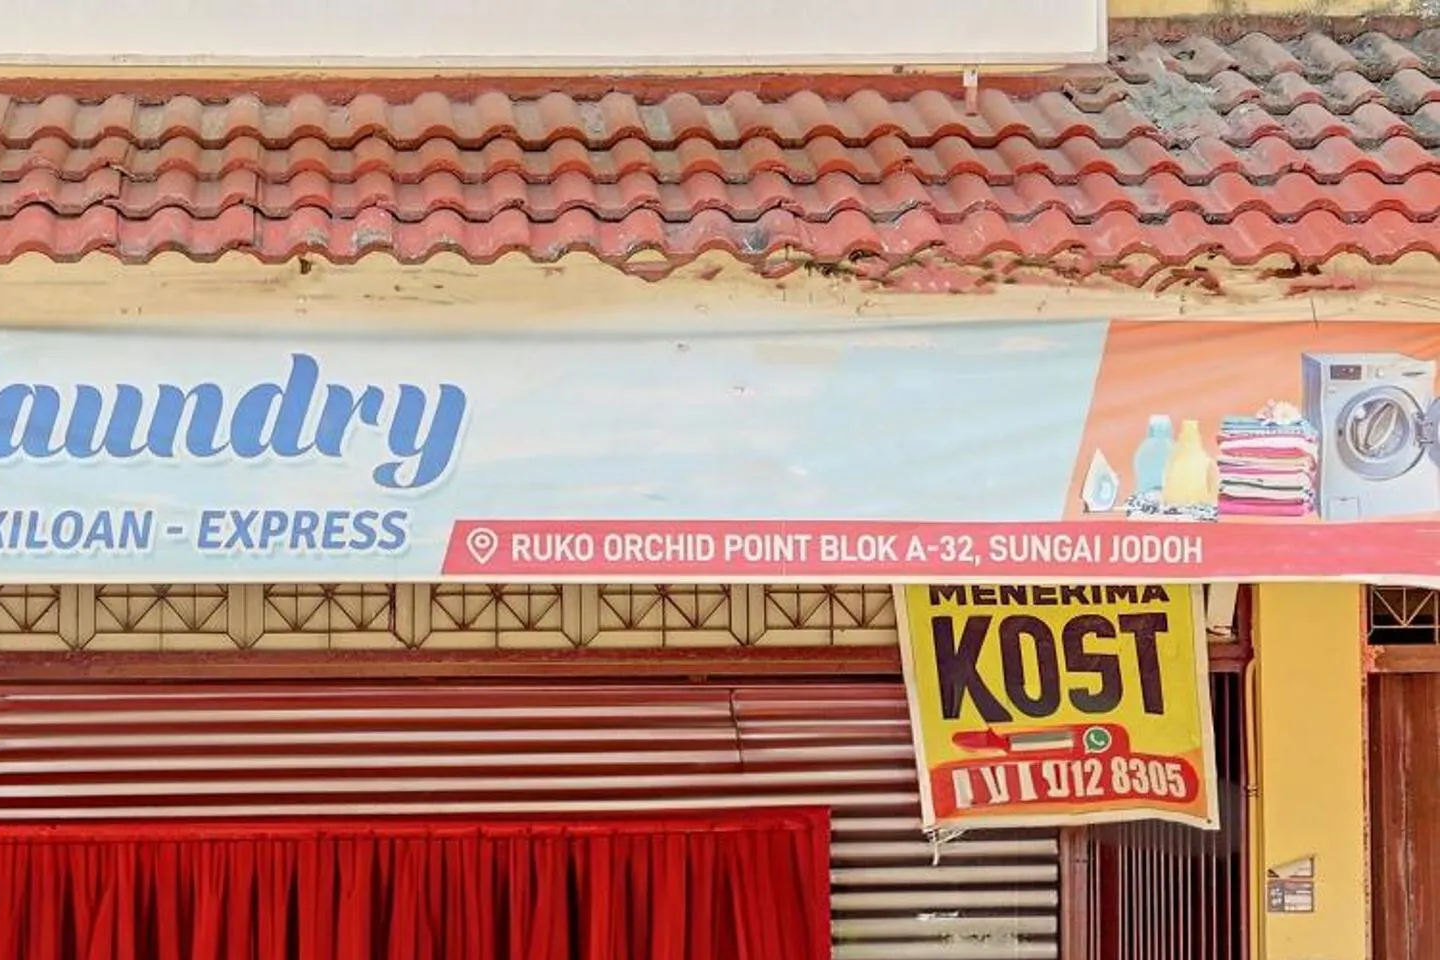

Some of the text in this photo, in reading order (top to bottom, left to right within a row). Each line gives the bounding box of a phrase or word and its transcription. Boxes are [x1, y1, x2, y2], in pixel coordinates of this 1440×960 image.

[197, 510, 408, 550] EXPRESS
[512, 533, 1204, 567] RUKO ORCHID POINT BLOK A-32, SUNGAI JODOH
[930, 611, 1169, 723] KOST
[1110, 755, 1187, 799] 8305
